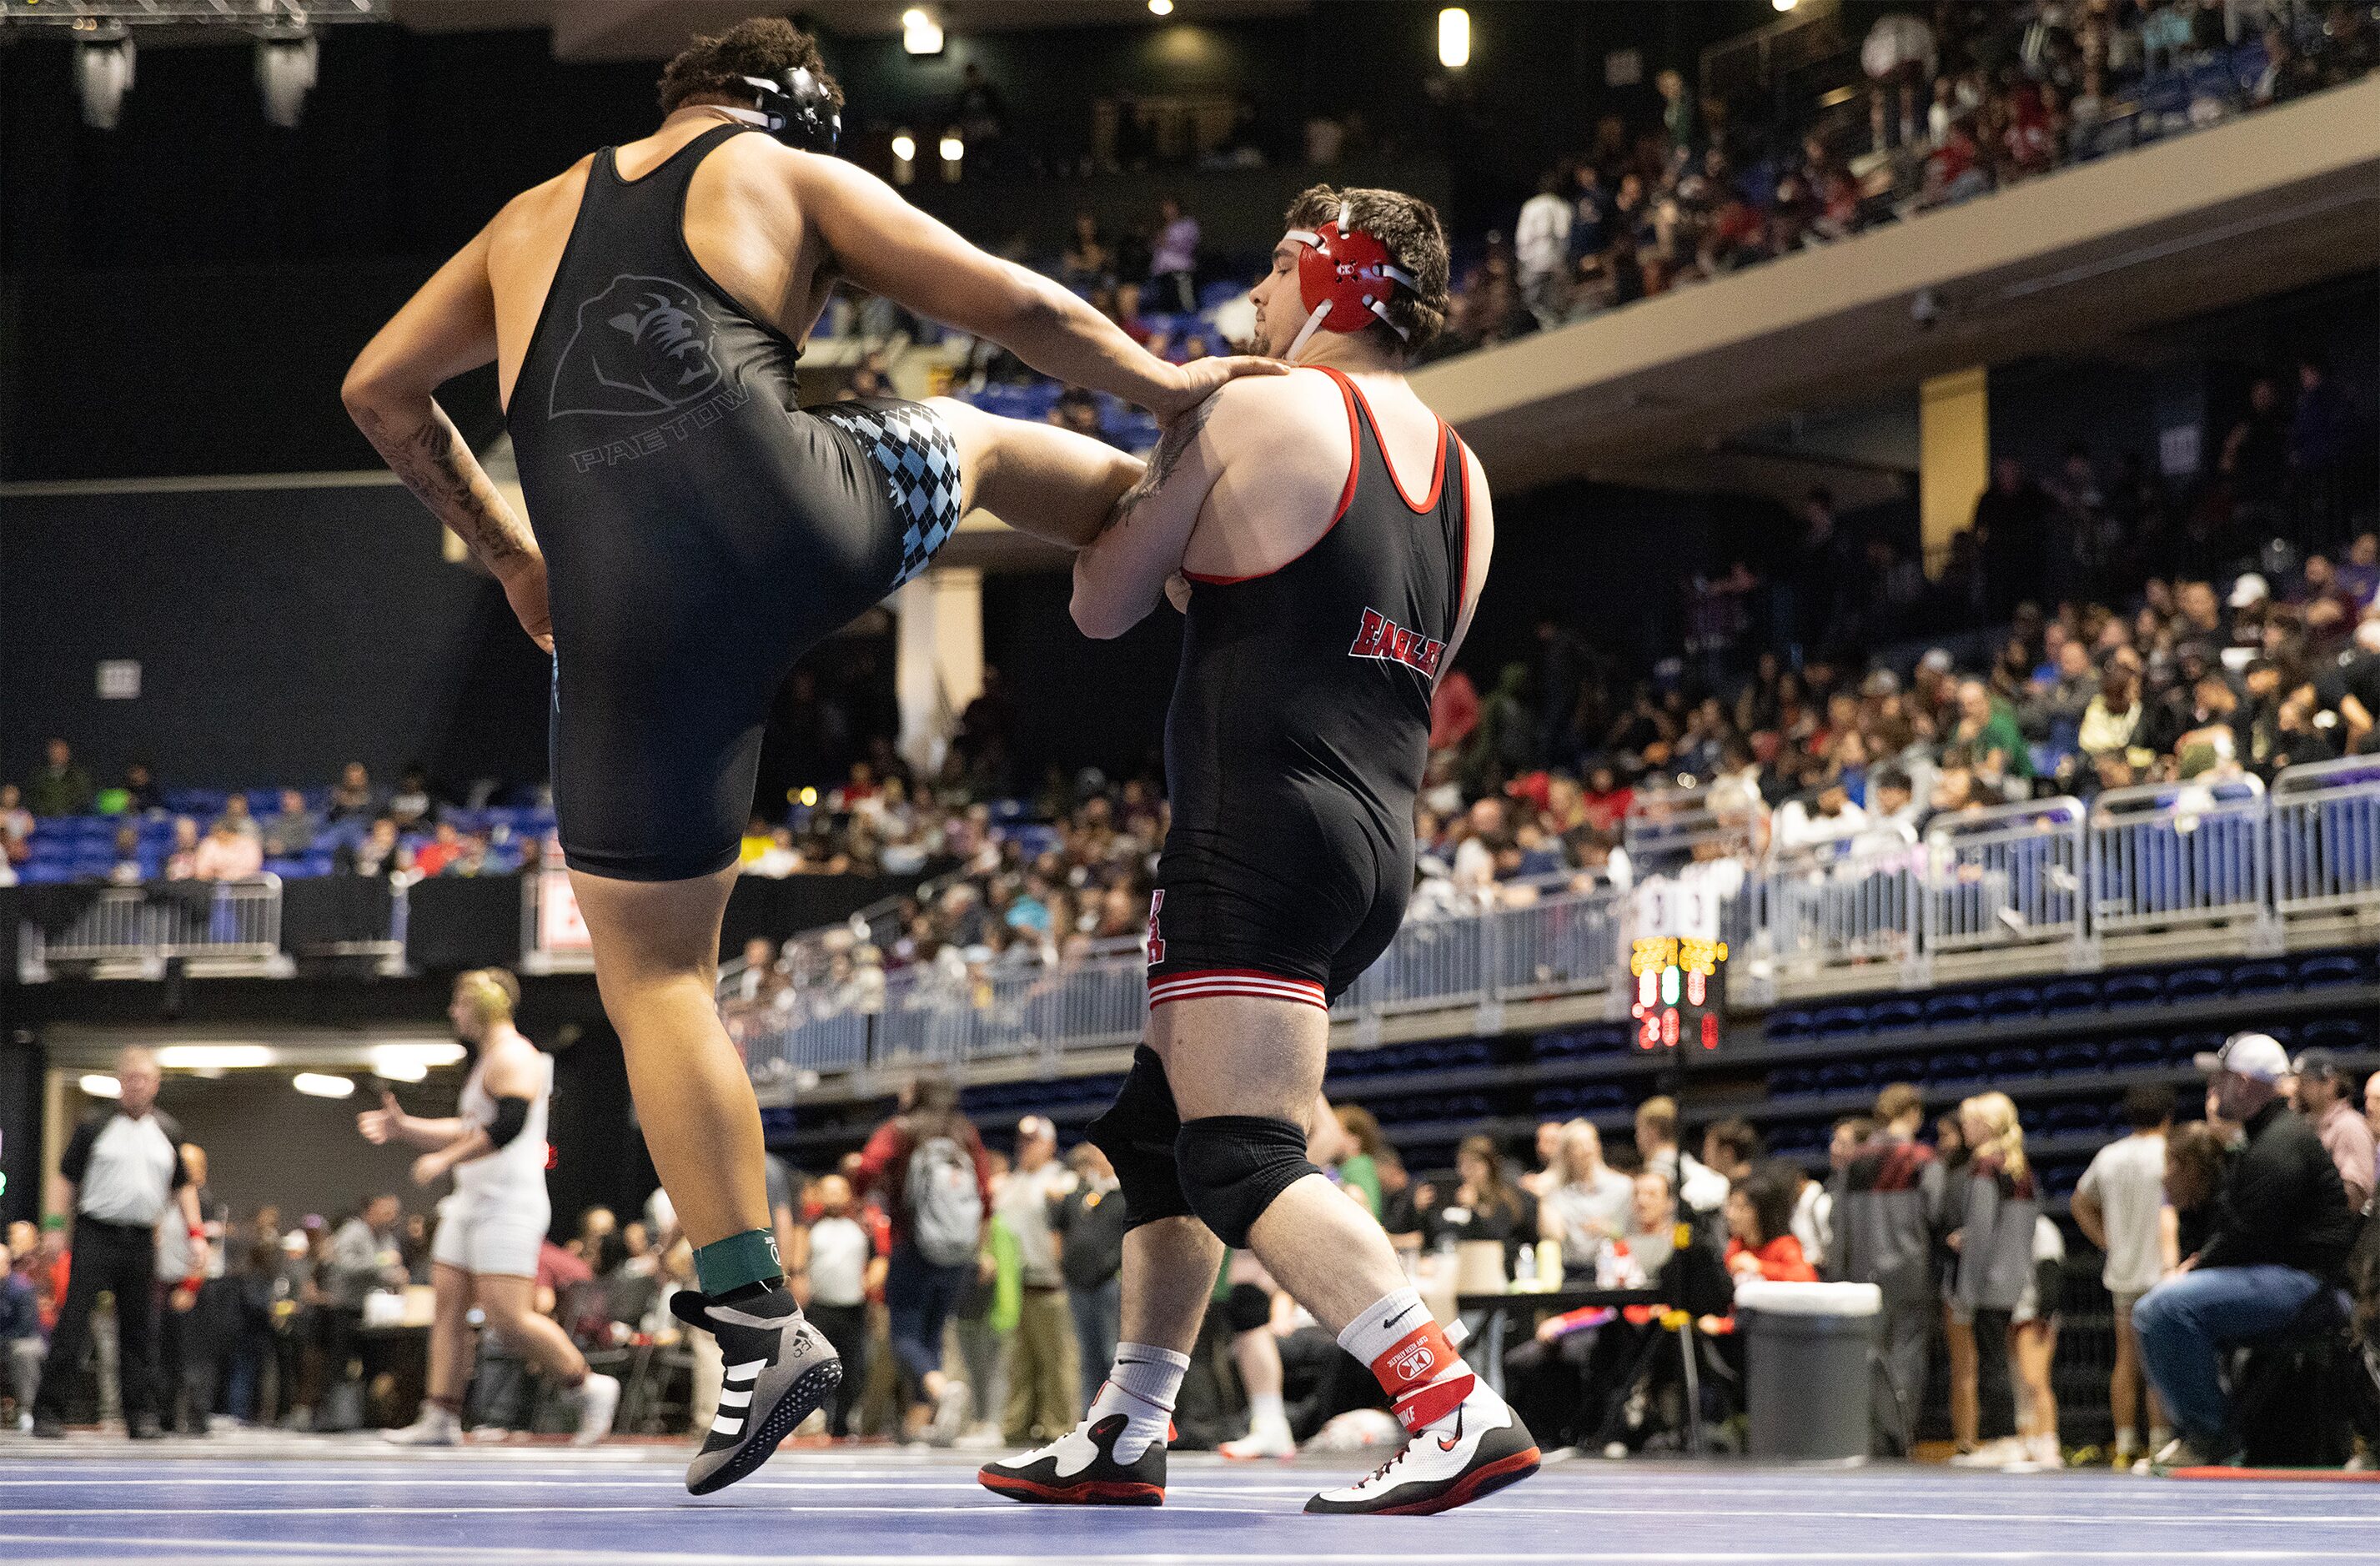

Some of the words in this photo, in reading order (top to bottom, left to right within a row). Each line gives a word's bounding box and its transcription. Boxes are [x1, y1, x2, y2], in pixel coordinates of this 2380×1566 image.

[569, 381, 751, 473] PAETOW
[1404, 1343, 1418, 1354] KEEN
[1416, 1335, 1429, 1348] CLIFF
[1387, 1349, 1407, 1368] ATHLETIC
